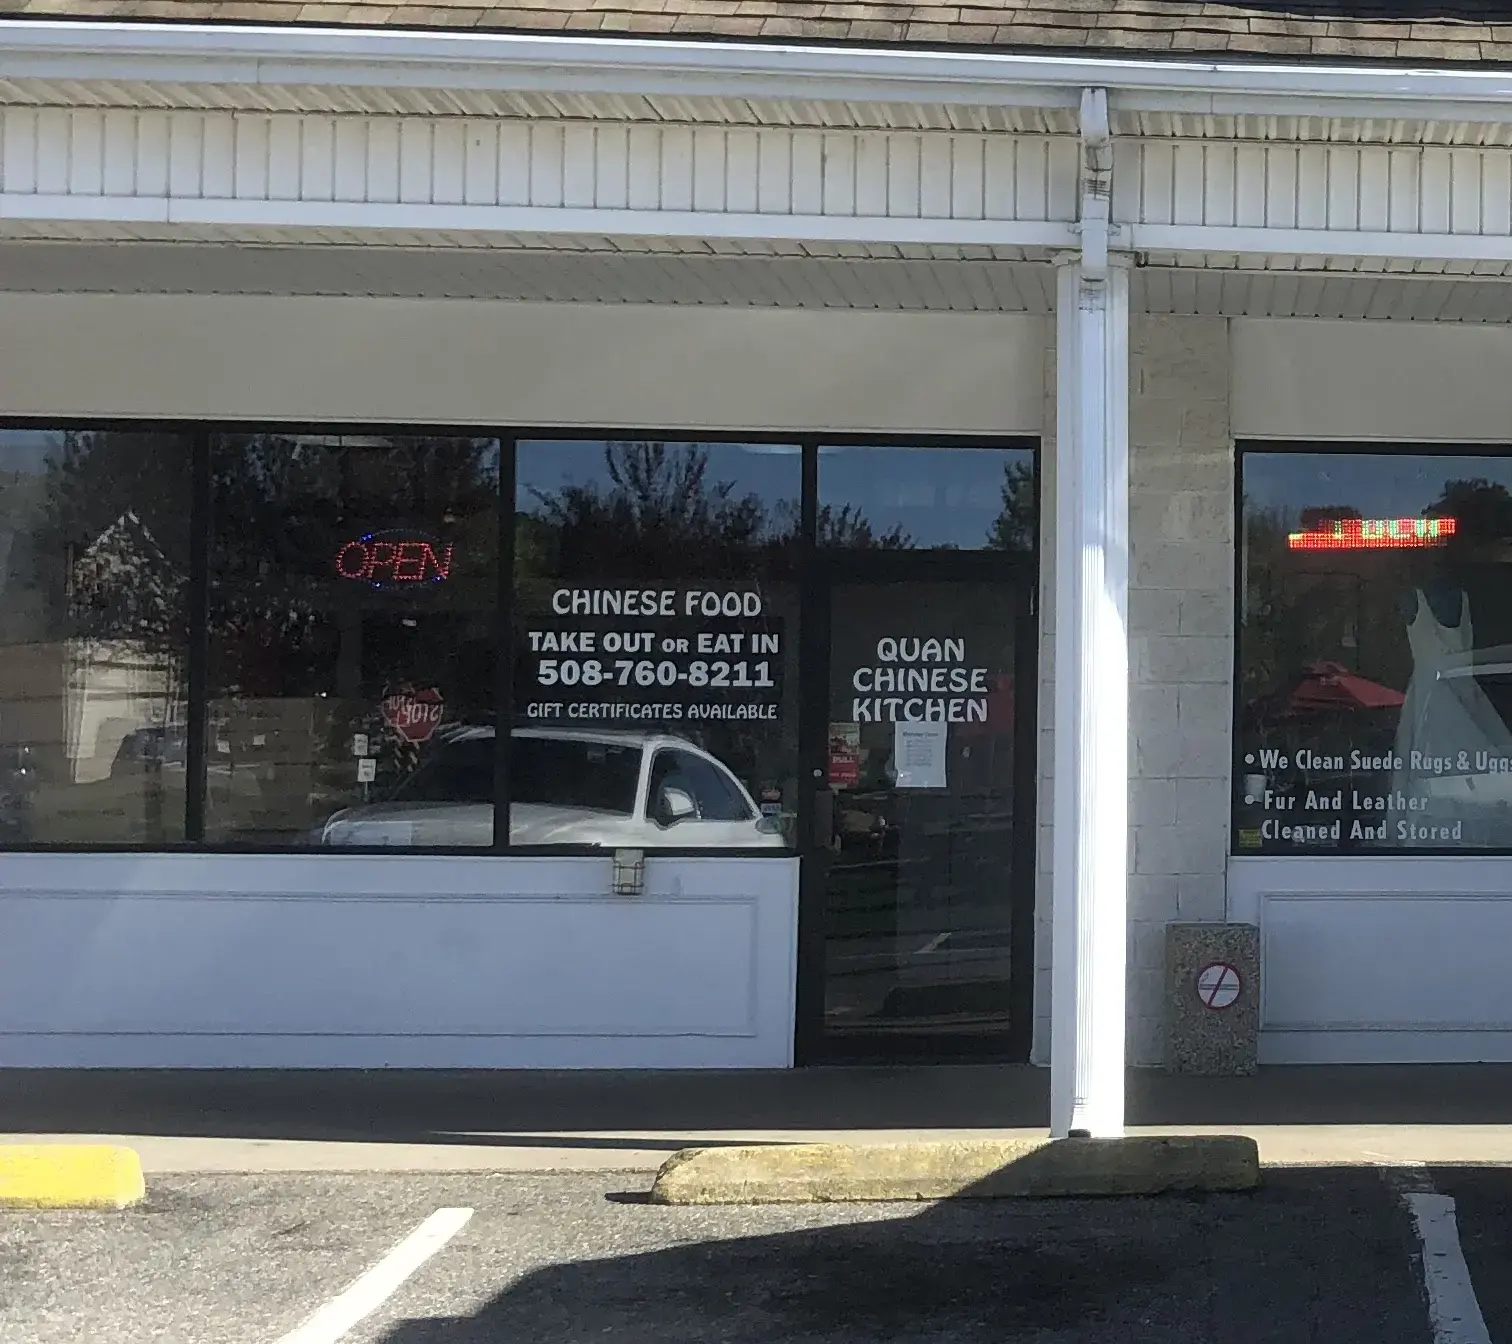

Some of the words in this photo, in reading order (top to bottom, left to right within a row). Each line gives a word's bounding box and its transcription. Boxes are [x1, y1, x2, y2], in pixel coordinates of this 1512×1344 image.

[336, 541, 453, 580] OPEN
[552, 589, 676, 617] CHINESE
[685, 591, 762, 617] FOOD
[528, 631, 595, 653] TAKE
[603, 632, 655, 654] OUT
[662, 639, 689, 654] OR
[697, 634, 744, 654] EAT
[752, 634, 779, 655] IN
[876, 637, 966, 663] QUAN
[538, 659, 775, 688] 508-760-8211
[852, 668, 989, 693] CHINESE
[527, 703, 564, 719] GIFT
[568, 703, 683, 720] CERTIFICATES
[687, 704, 778, 720] AVAILABLE
[851, 698, 989, 723] KITCHEN
[1259, 749, 1288, 770] We
[1296, 750, 1344, 770] Clean
[1351, 750, 1402, 770] Suede
[1411, 751, 1451, 774] Rugs
[1456, 752, 1470, 770] &
[1264, 790, 1296, 810] Fur
[1305, 790, 1342, 810] And
[1352, 790, 1428, 810] Leather
[1261, 820, 1341, 840] Cleaned
[1350, 820, 1387, 840] And
[1397, 820, 1462, 841] Stored
